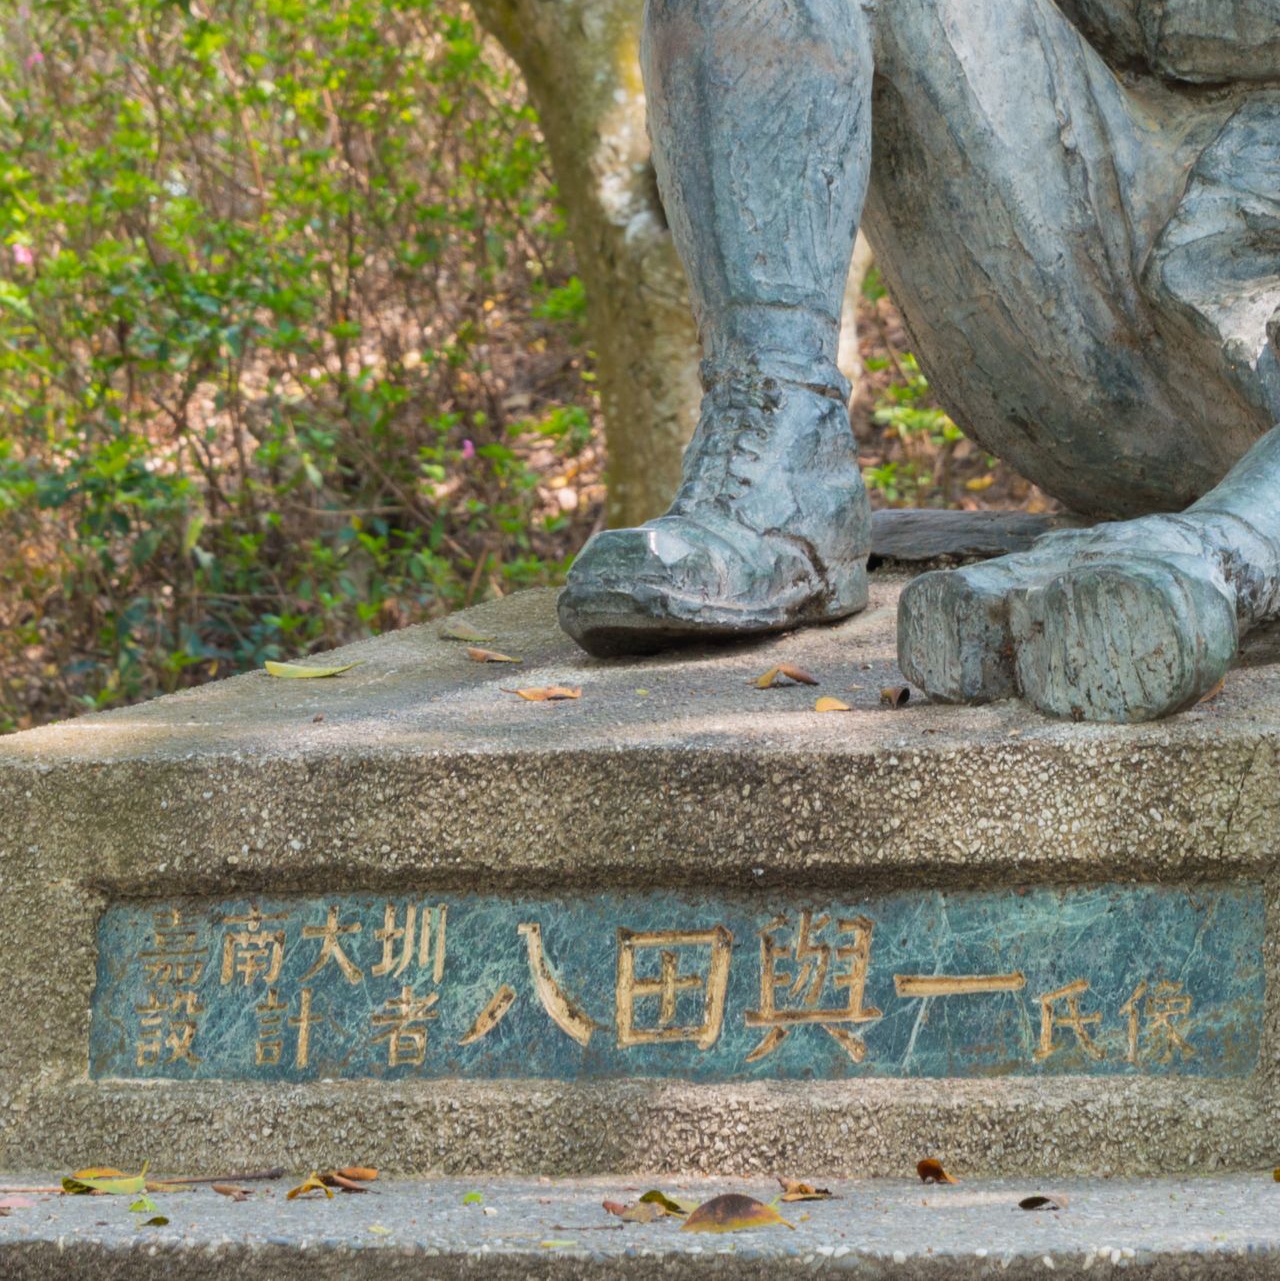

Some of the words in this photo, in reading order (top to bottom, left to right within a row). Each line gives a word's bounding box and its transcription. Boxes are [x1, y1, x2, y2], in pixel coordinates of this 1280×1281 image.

[139, 903, 448, 985] 嘉南大圳
[136, 987, 440, 1070] 設計者
